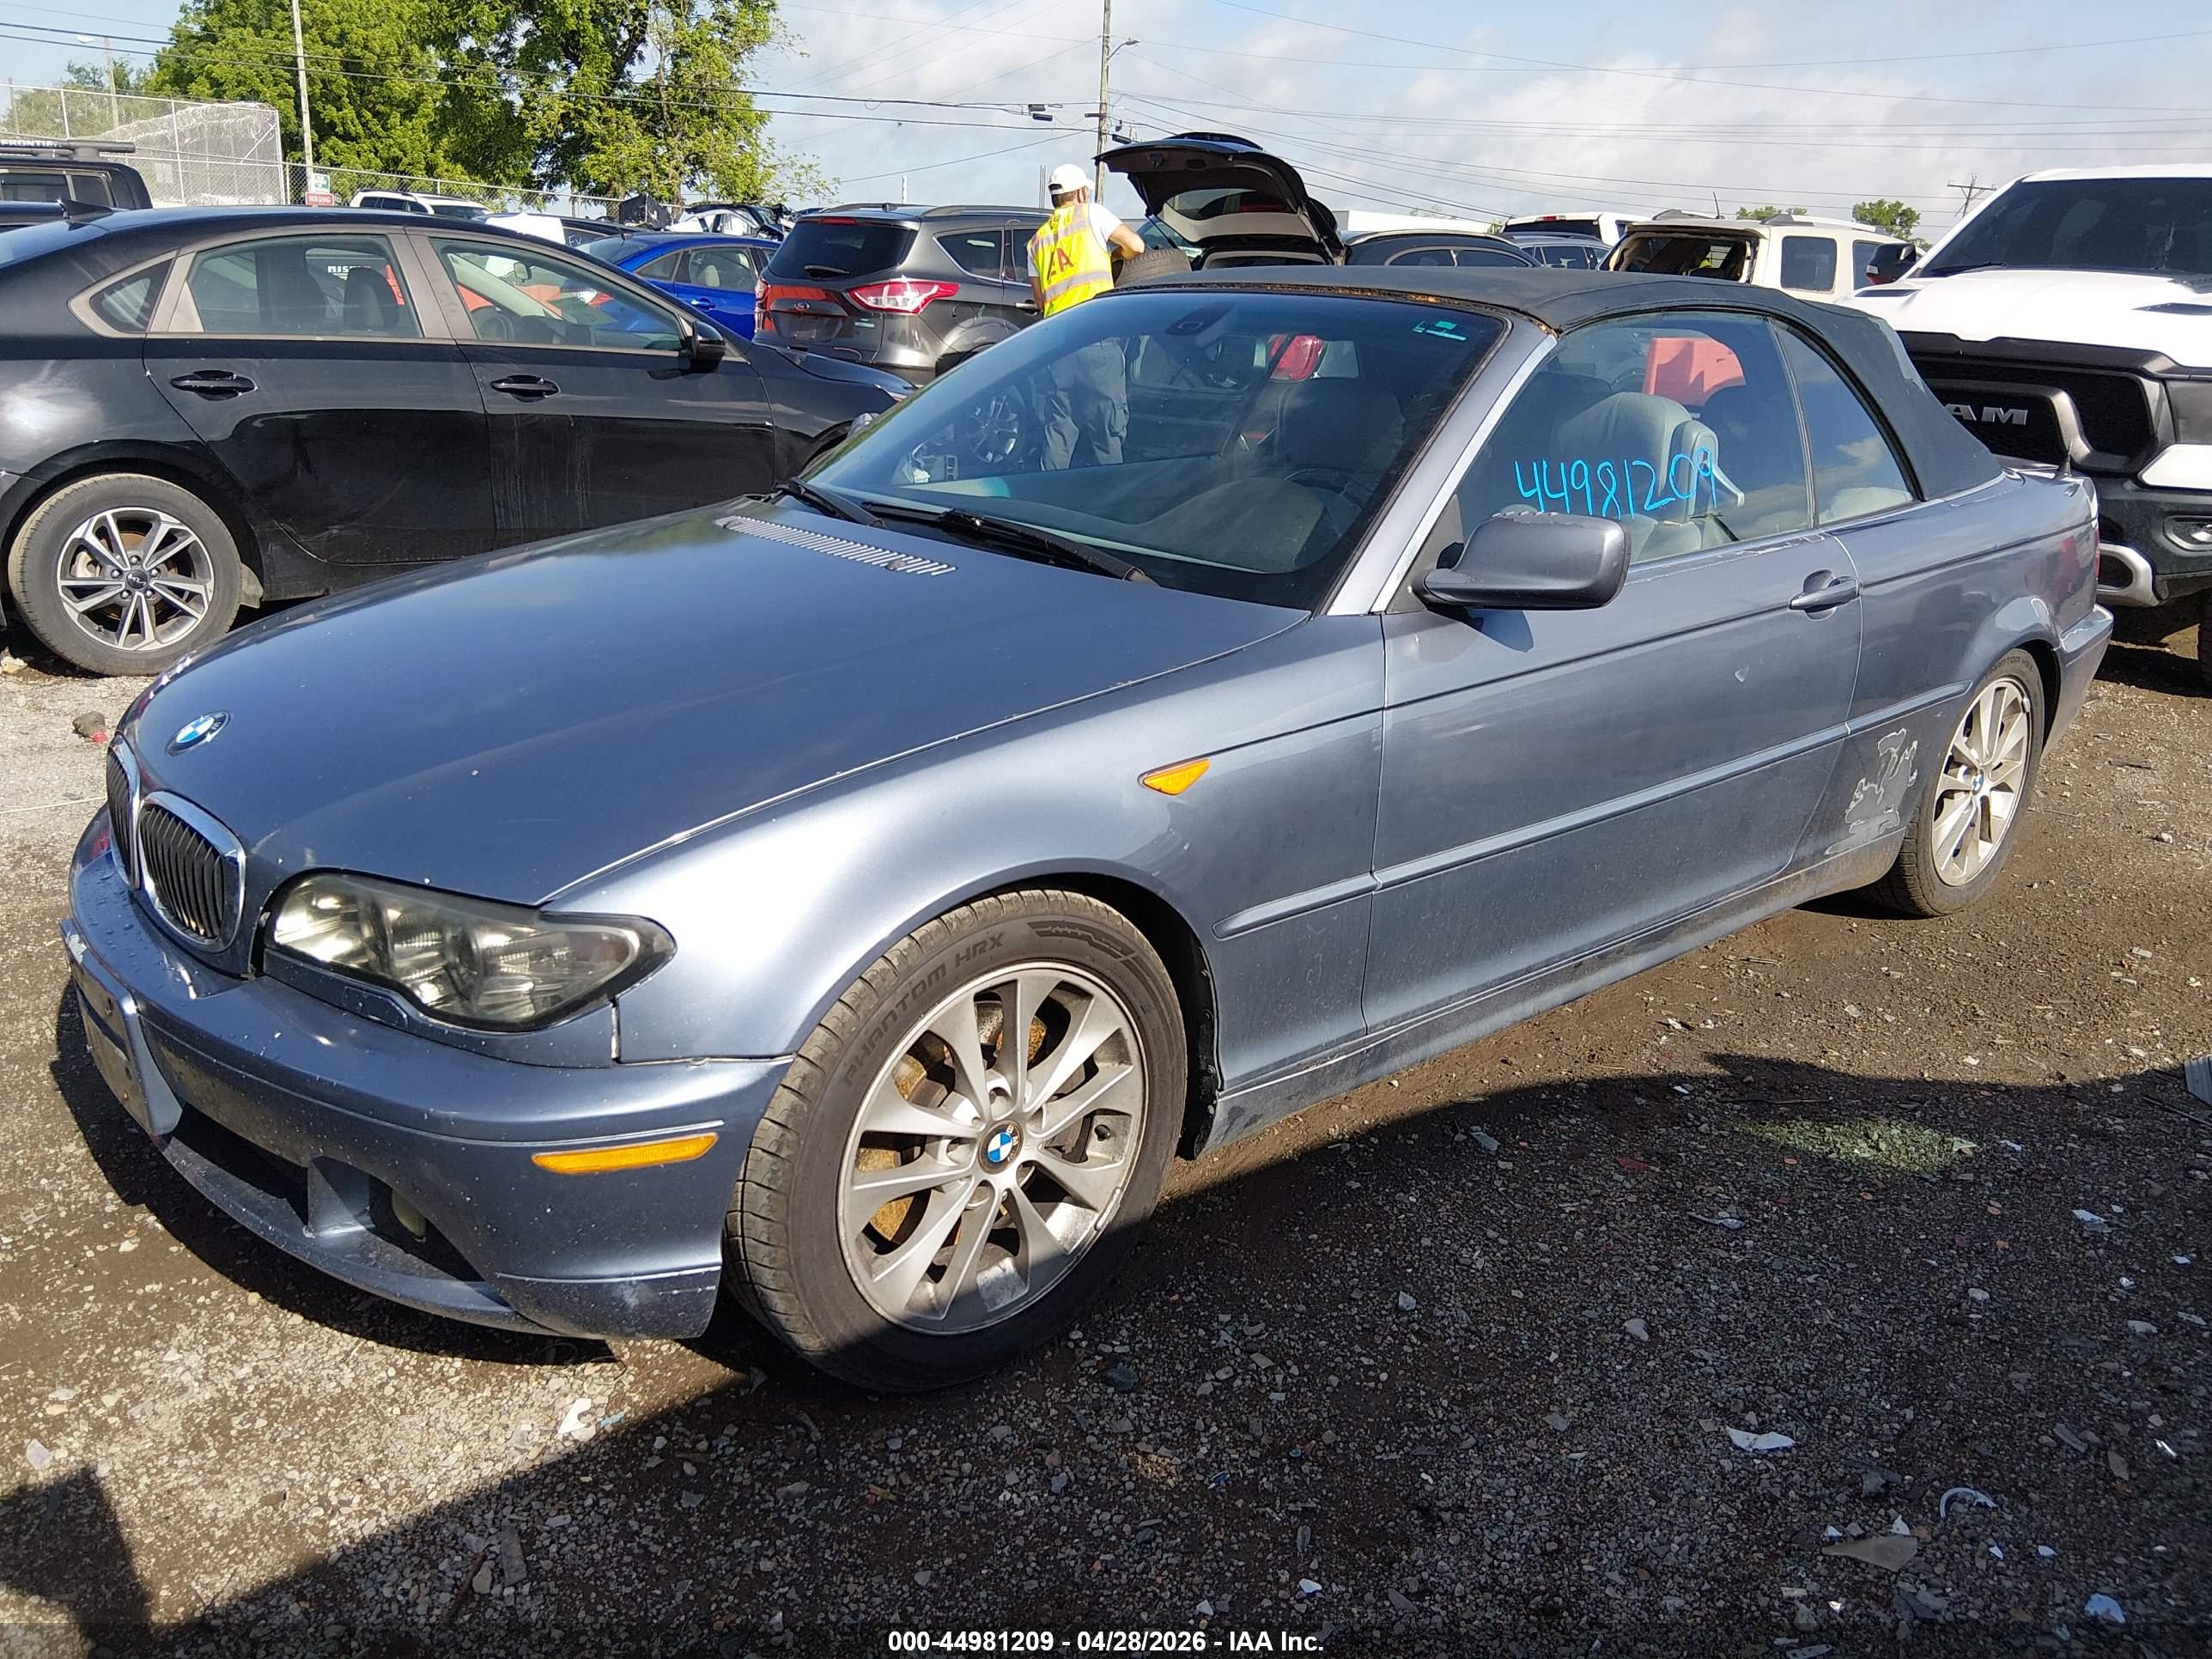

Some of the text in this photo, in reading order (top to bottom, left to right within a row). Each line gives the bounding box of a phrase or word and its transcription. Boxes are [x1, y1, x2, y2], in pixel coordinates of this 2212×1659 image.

[308, 195, 331, 204] WRONG
[1944, 404, 2028, 426] AM
[1514, 446, 1717, 521] 44981209
[843, 933, 1005, 1086] PHANTOM HRX
